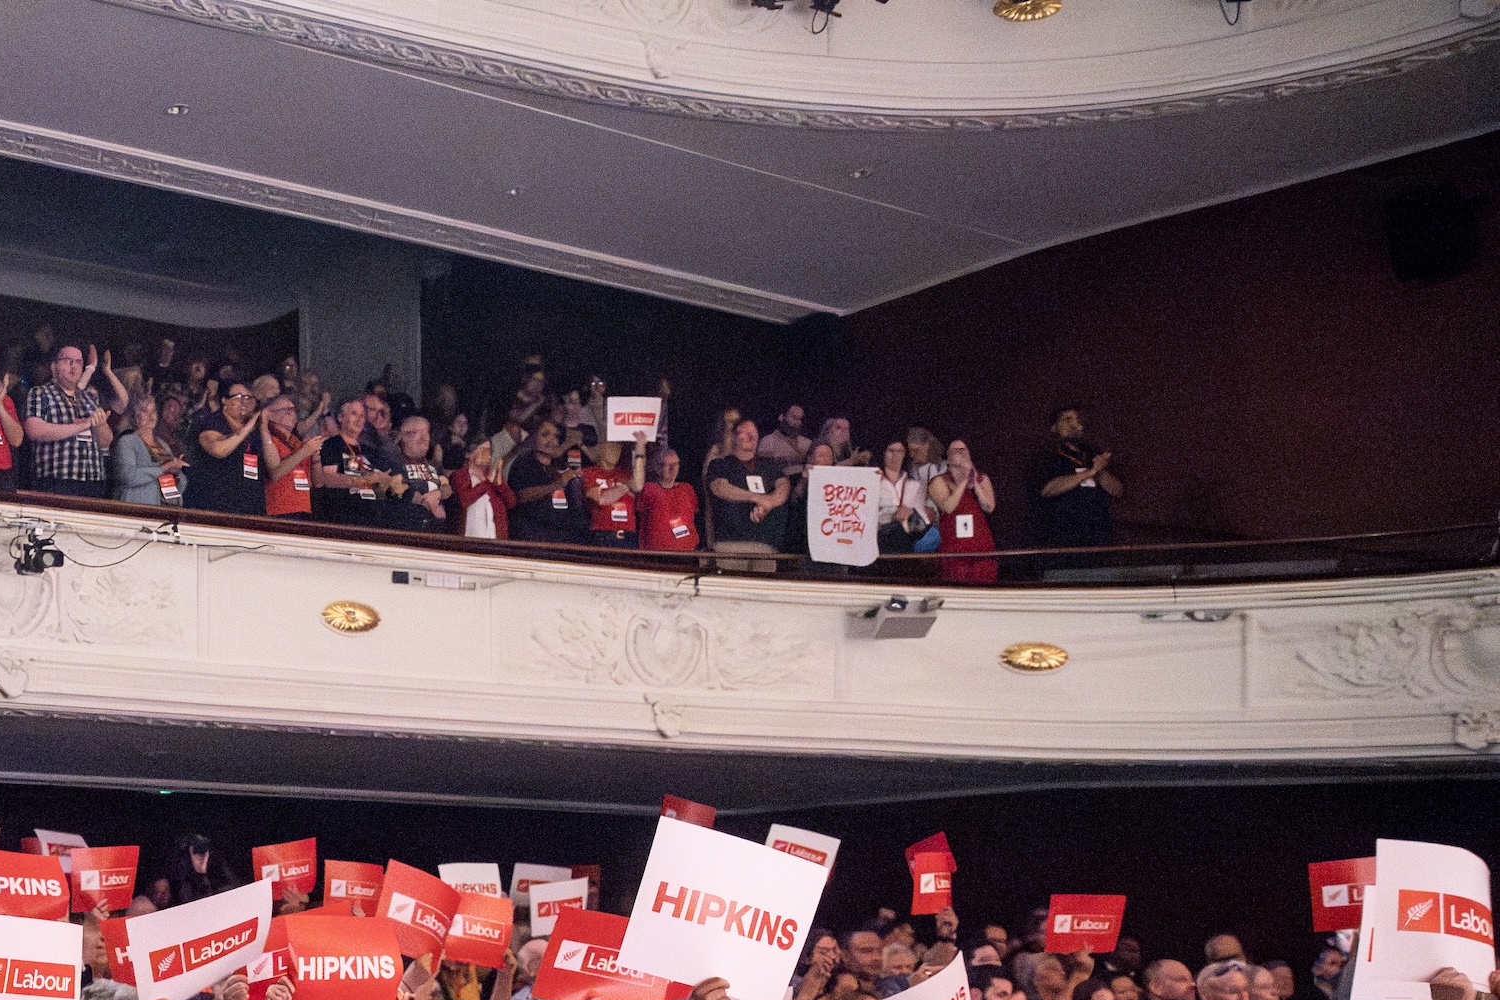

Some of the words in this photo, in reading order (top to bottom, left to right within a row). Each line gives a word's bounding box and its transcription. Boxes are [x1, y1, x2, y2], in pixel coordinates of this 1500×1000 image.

[823, 484, 867, 504] BRING
[102, 872, 131, 886] Labour
[652, 881, 798, 951] HIPKINS
[464, 921, 501, 939] Labour
[190, 928, 253, 965] Labour
[13, 968, 72, 992] Labour
[298, 955, 396, 981] HIPKINS
